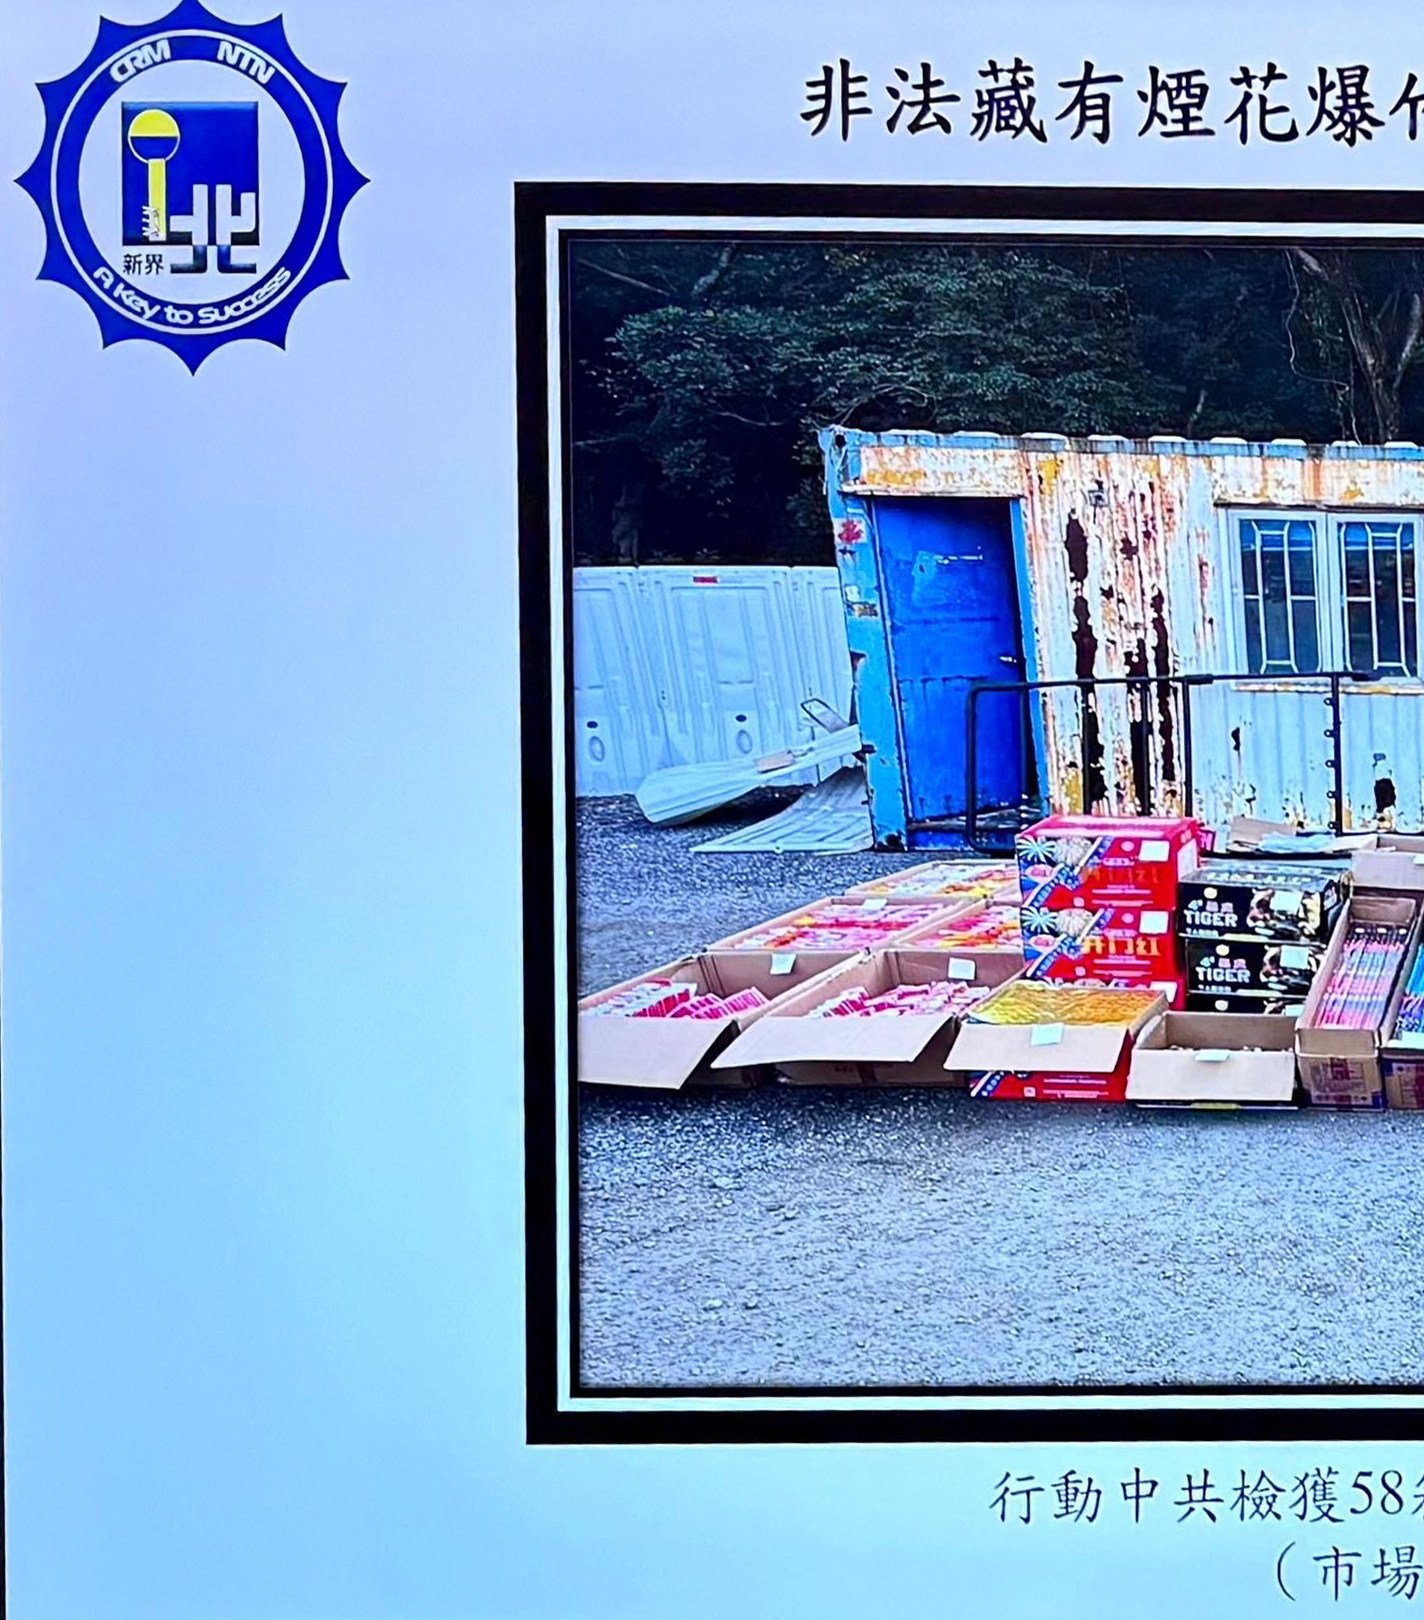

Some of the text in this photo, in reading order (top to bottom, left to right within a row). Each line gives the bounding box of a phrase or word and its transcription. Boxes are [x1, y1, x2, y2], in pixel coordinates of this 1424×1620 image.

[109, 39, 276, 84] CRM NTN
[122, 254, 164, 275] 新界
[93, 265, 291, 324] A Key to Success
[1183, 910, 1238, 928] TIGER
[1195, 966, 1251, 983] TIGER
